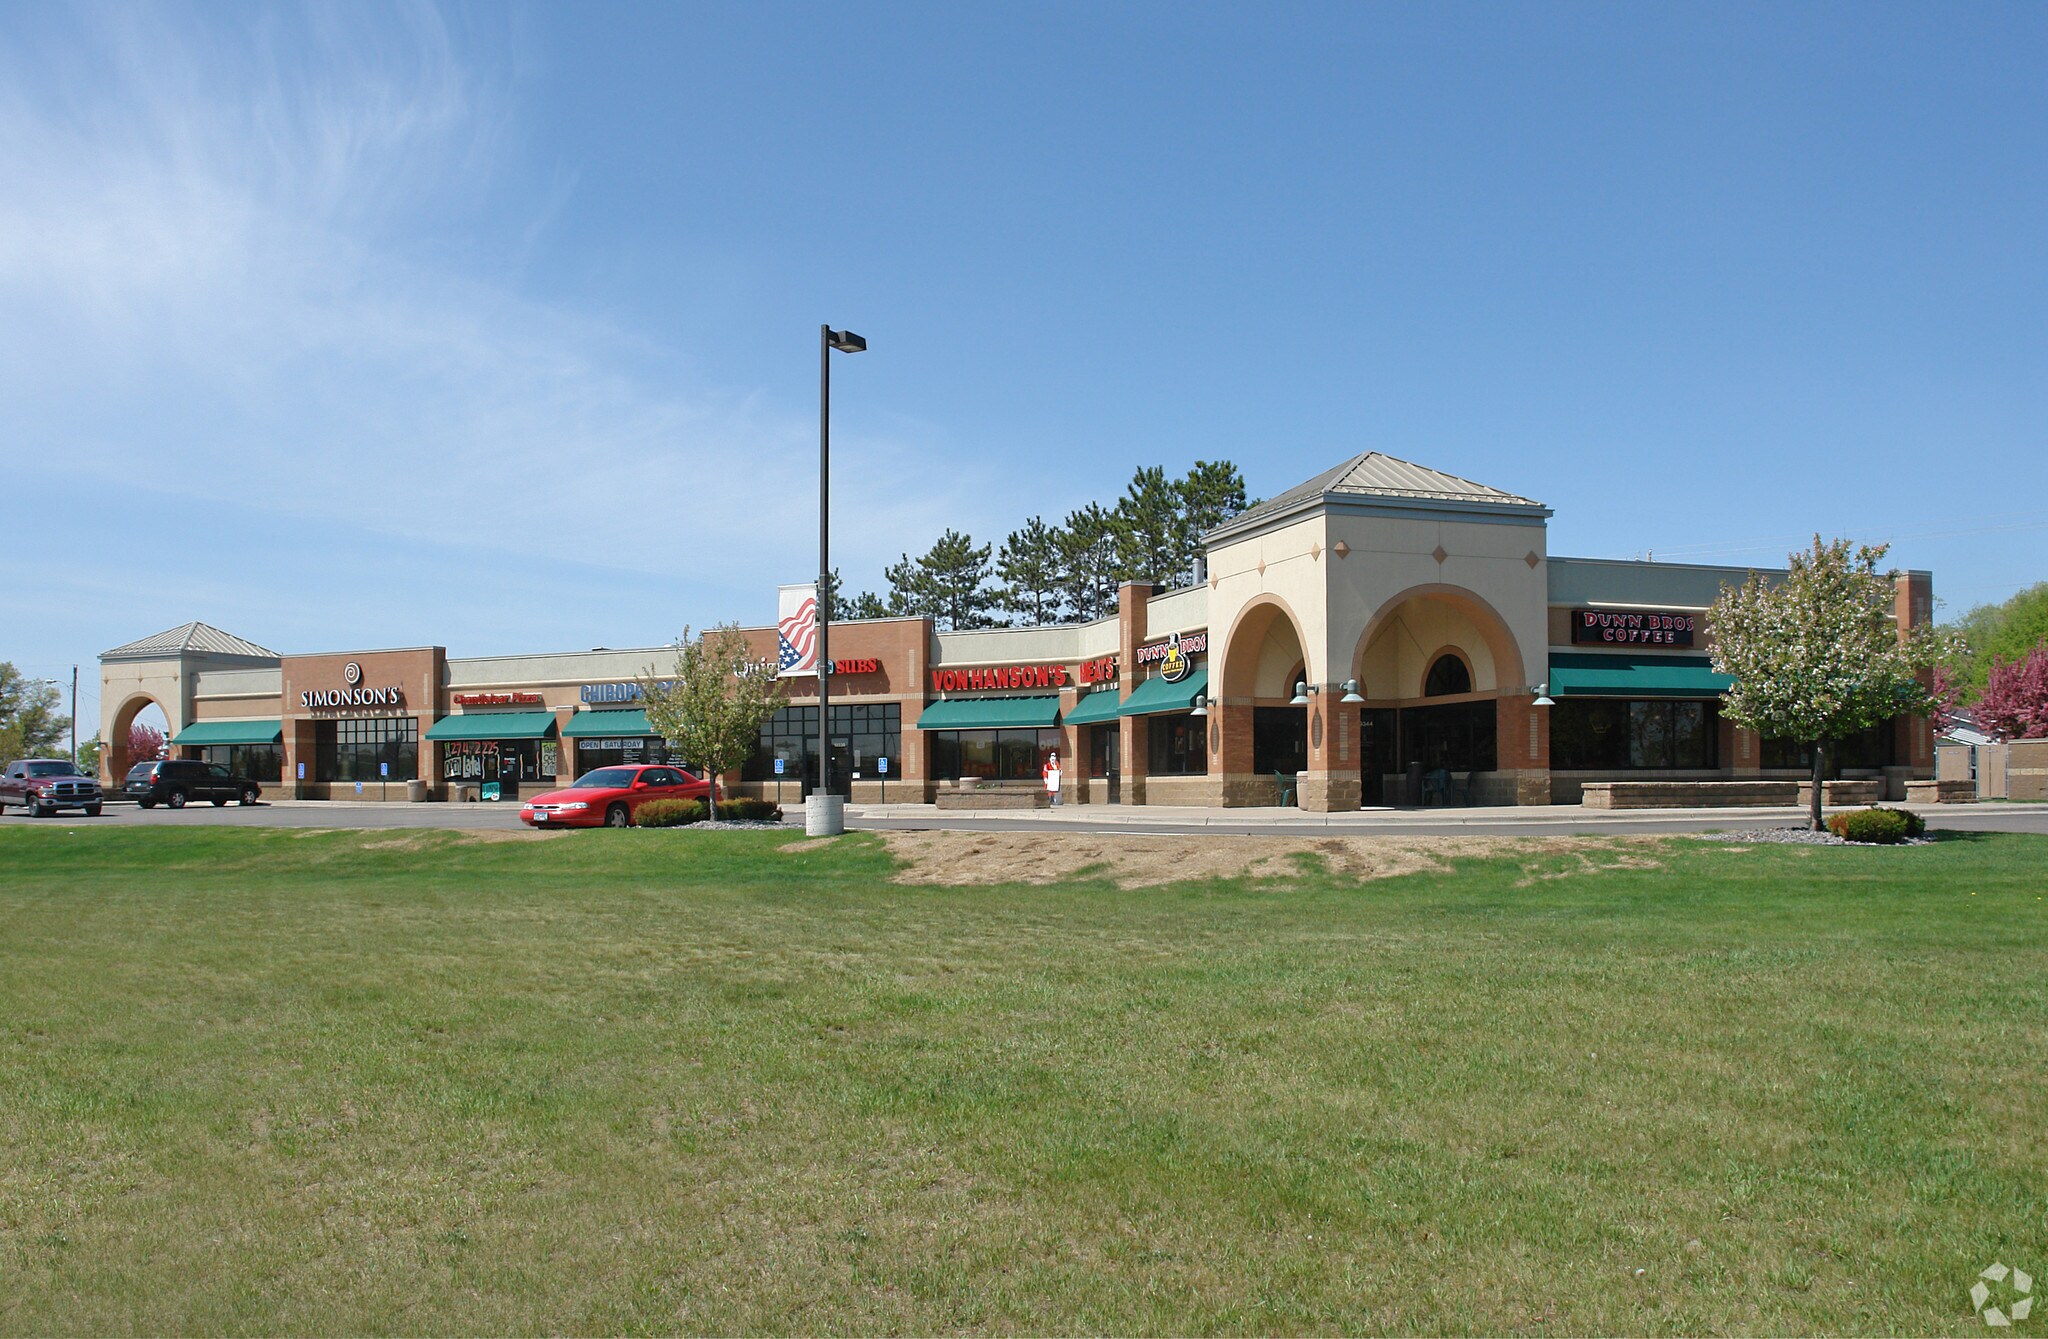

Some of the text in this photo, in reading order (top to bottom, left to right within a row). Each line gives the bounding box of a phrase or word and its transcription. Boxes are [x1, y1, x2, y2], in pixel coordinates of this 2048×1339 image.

[1584, 612, 1694, 631] DUNN BROS
[1603, 628, 1675, 643] COFFEE
[1137, 634, 1207, 663] DUNN BROS
[836, 658, 877, 674] SUBS
[1080, 656, 1113, 684] MEATS
[932, 664, 1067, 691] VON HANSON'S
[301, 687, 398, 707] SIMONSON'S
[580, 740, 641, 749] OPEN SATURDAY
